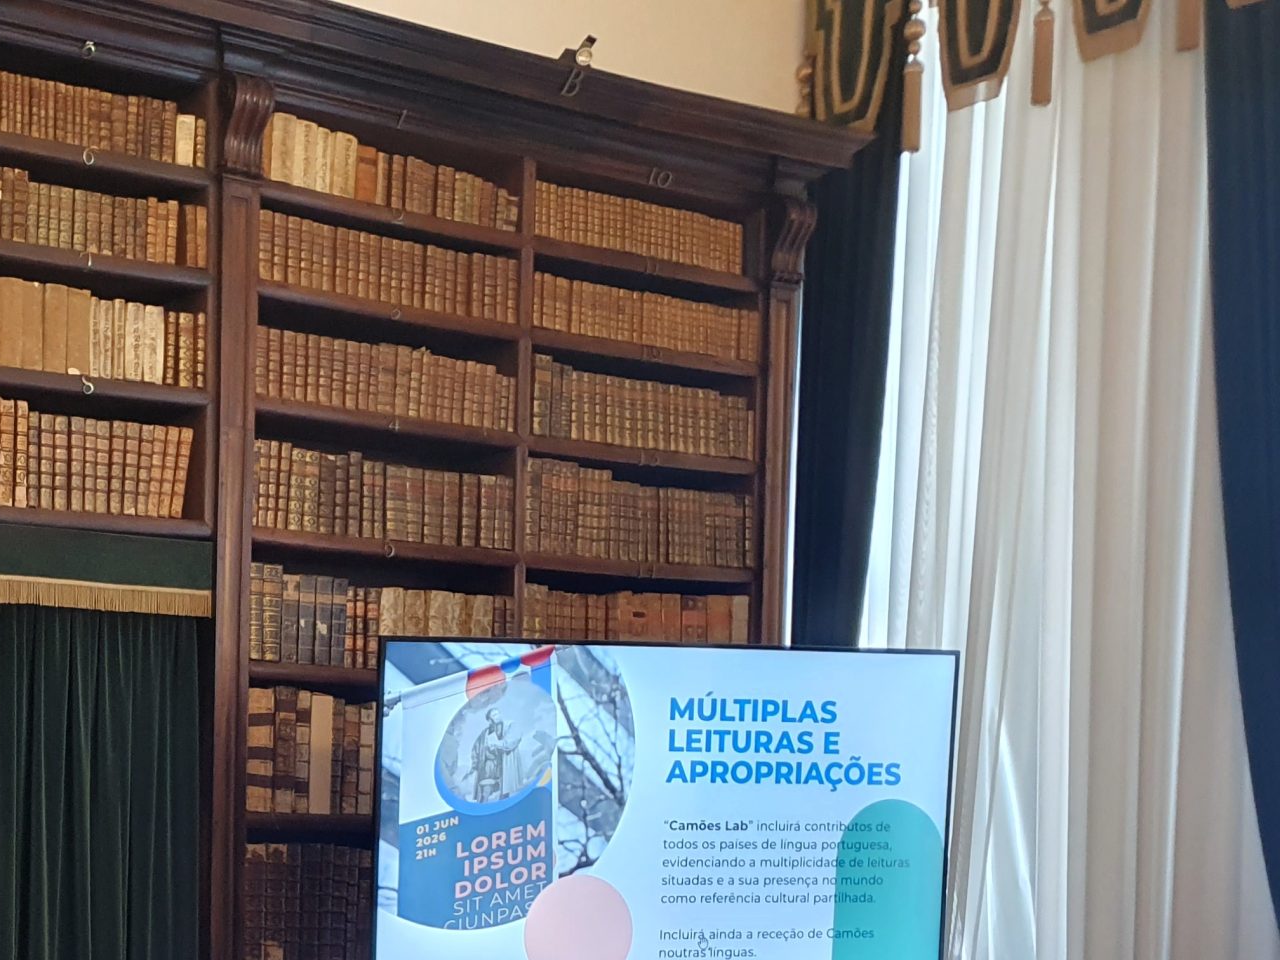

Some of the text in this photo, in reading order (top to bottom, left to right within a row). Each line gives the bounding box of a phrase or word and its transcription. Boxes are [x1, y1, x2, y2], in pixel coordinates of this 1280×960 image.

[83, 144, 99, 166] 6
[648, 167, 673, 189] 10
[669, 691, 838, 724] MÚLTIPLAS
[668, 728, 841, 755] LEITURAS E
[665, 755, 902, 792] APROPRIAÇÕES
[416, 816, 460, 835] 01 JUN
[756, 820, 801, 832] incluirá
[804, 820, 873, 833] contributos
[875, 821, 891, 833] de
[415, 832, 447, 848] 2026
[456, 820, 546, 859] LOREM
[663, 838, 893, 854] todos os países de língua portuguesa,
[415, 848, 437, 860] 21H
[463, 841, 546, 877] IPSUM
[662, 856, 910, 871] evidenciando a multiplicidade de leituras
[454, 862, 547, 899] DOLOR
[661, 874, 884, 890] situadas e a sua presença no mundo
[453, 880, 547, 916] SIT AMET
[660, 892, 876, 906] como referência cultural partilhada.
[659, 927, 875, 943] Incluirá ainda a receção de Camões
[658, 946, 707, 959] noutras
